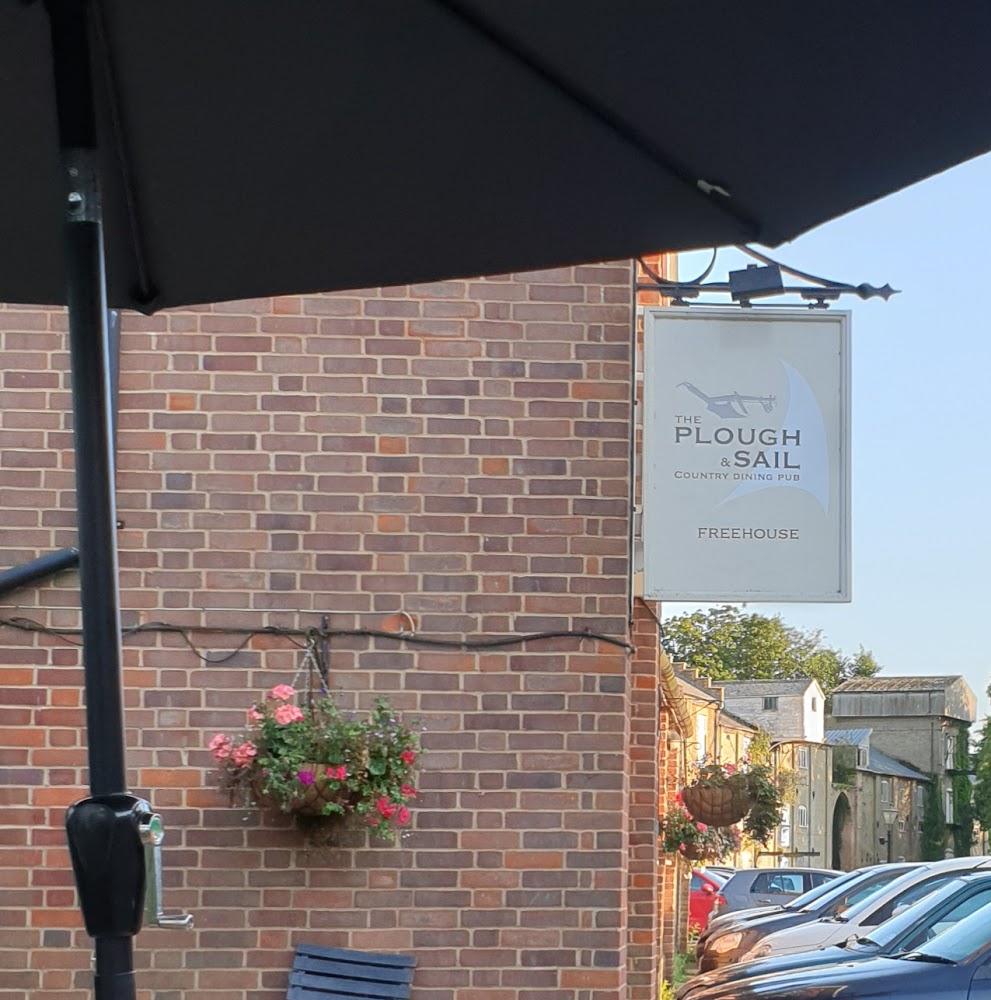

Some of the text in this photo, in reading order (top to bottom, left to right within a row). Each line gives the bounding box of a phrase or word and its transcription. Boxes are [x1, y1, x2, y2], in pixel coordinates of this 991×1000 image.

[675, 415, 701, 424] THE
[675, 426, 801, 446] PLOUGH
[720, 450, 801, 469] & SAIL
[733, 473, 773, 481] DINING
[698, 527, 799, 540] FREEHOUSE
